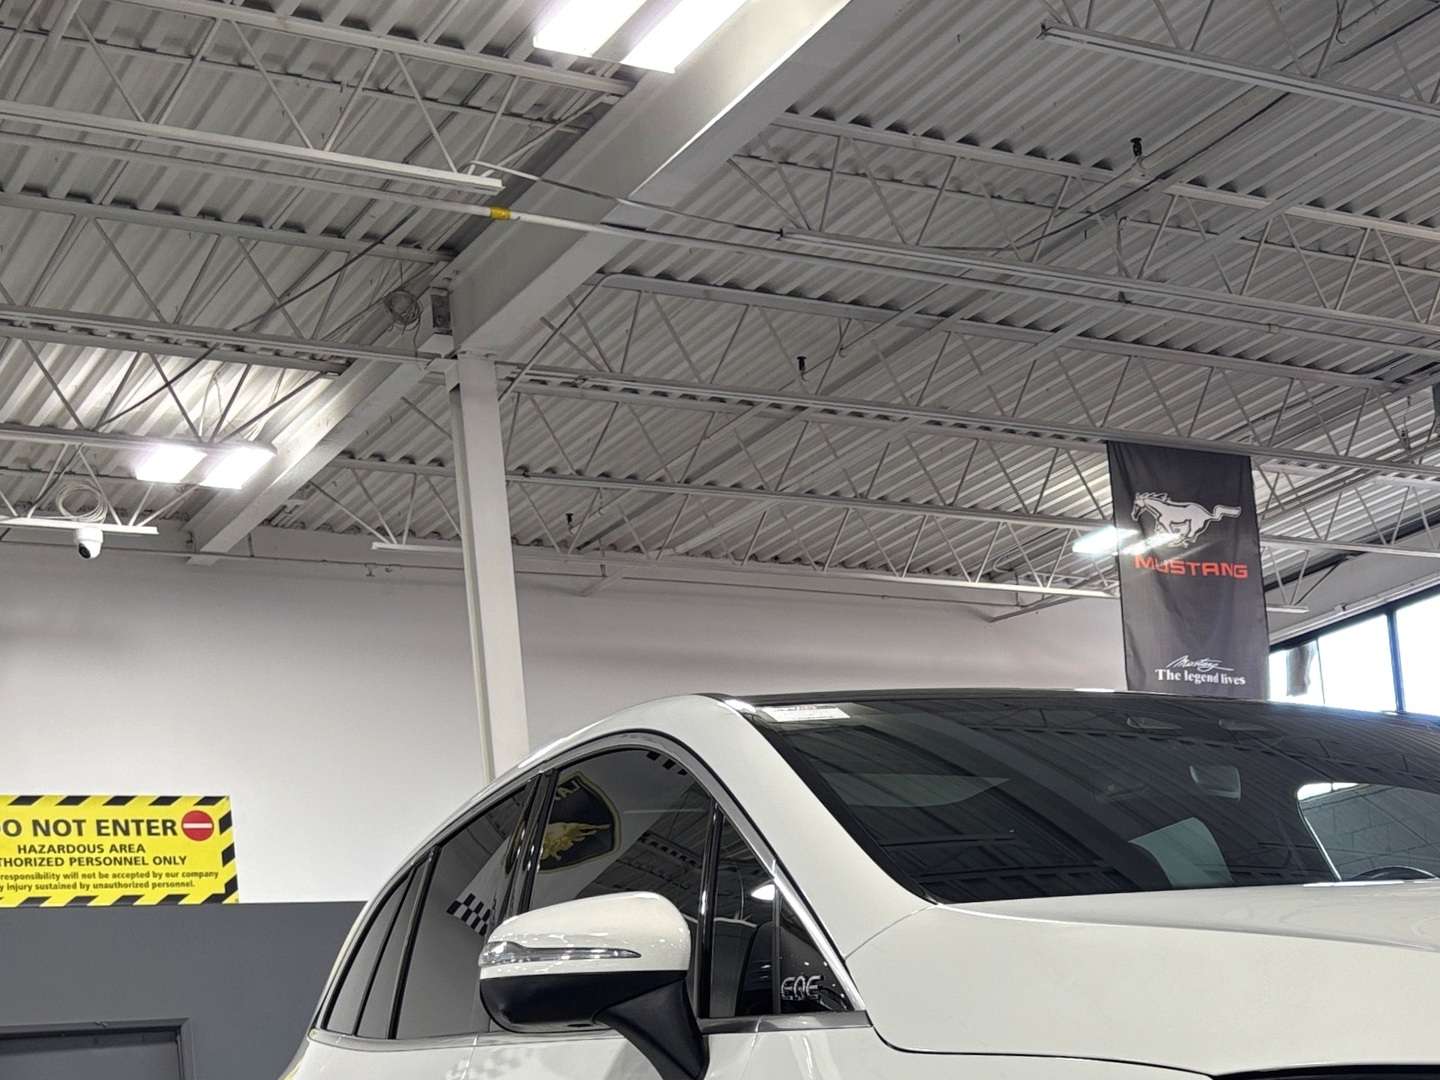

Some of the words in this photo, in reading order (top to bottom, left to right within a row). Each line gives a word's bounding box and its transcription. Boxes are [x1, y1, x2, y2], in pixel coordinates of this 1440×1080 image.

[1134, 555, 1249, 579] MUSTANG
[1155, 669, 1182, 681] The
[1184, 670, 1219, 685] legend
[1221, 673, 1246, 685] lives
[0, 819, 22, 837] O
[32, 819, 86, 837] NOT
[96, 819, 178, 836] ENTER
[17, 844, 105, 854] HAZARDOUS
[109, 843, 146, 853] AREA
[0, 857, 64, 867] THORIZED
[69, 856, 149, 866] PERSONNEL
[153, 855, 187, 865] ONLY
[0, 872, 60, 881] responsibility
[63, 871, 79, 879] will
[112, 871, 150, 880] accepted
[152, 871, 163, 879] by
[181, 871, 219, 879] company
[35, 882, 77, 890] sustained
[80, 882, 90, 891] by
[93, 881, 149, 890] unauthorized
[151, 880, 195, 889] personnel.
